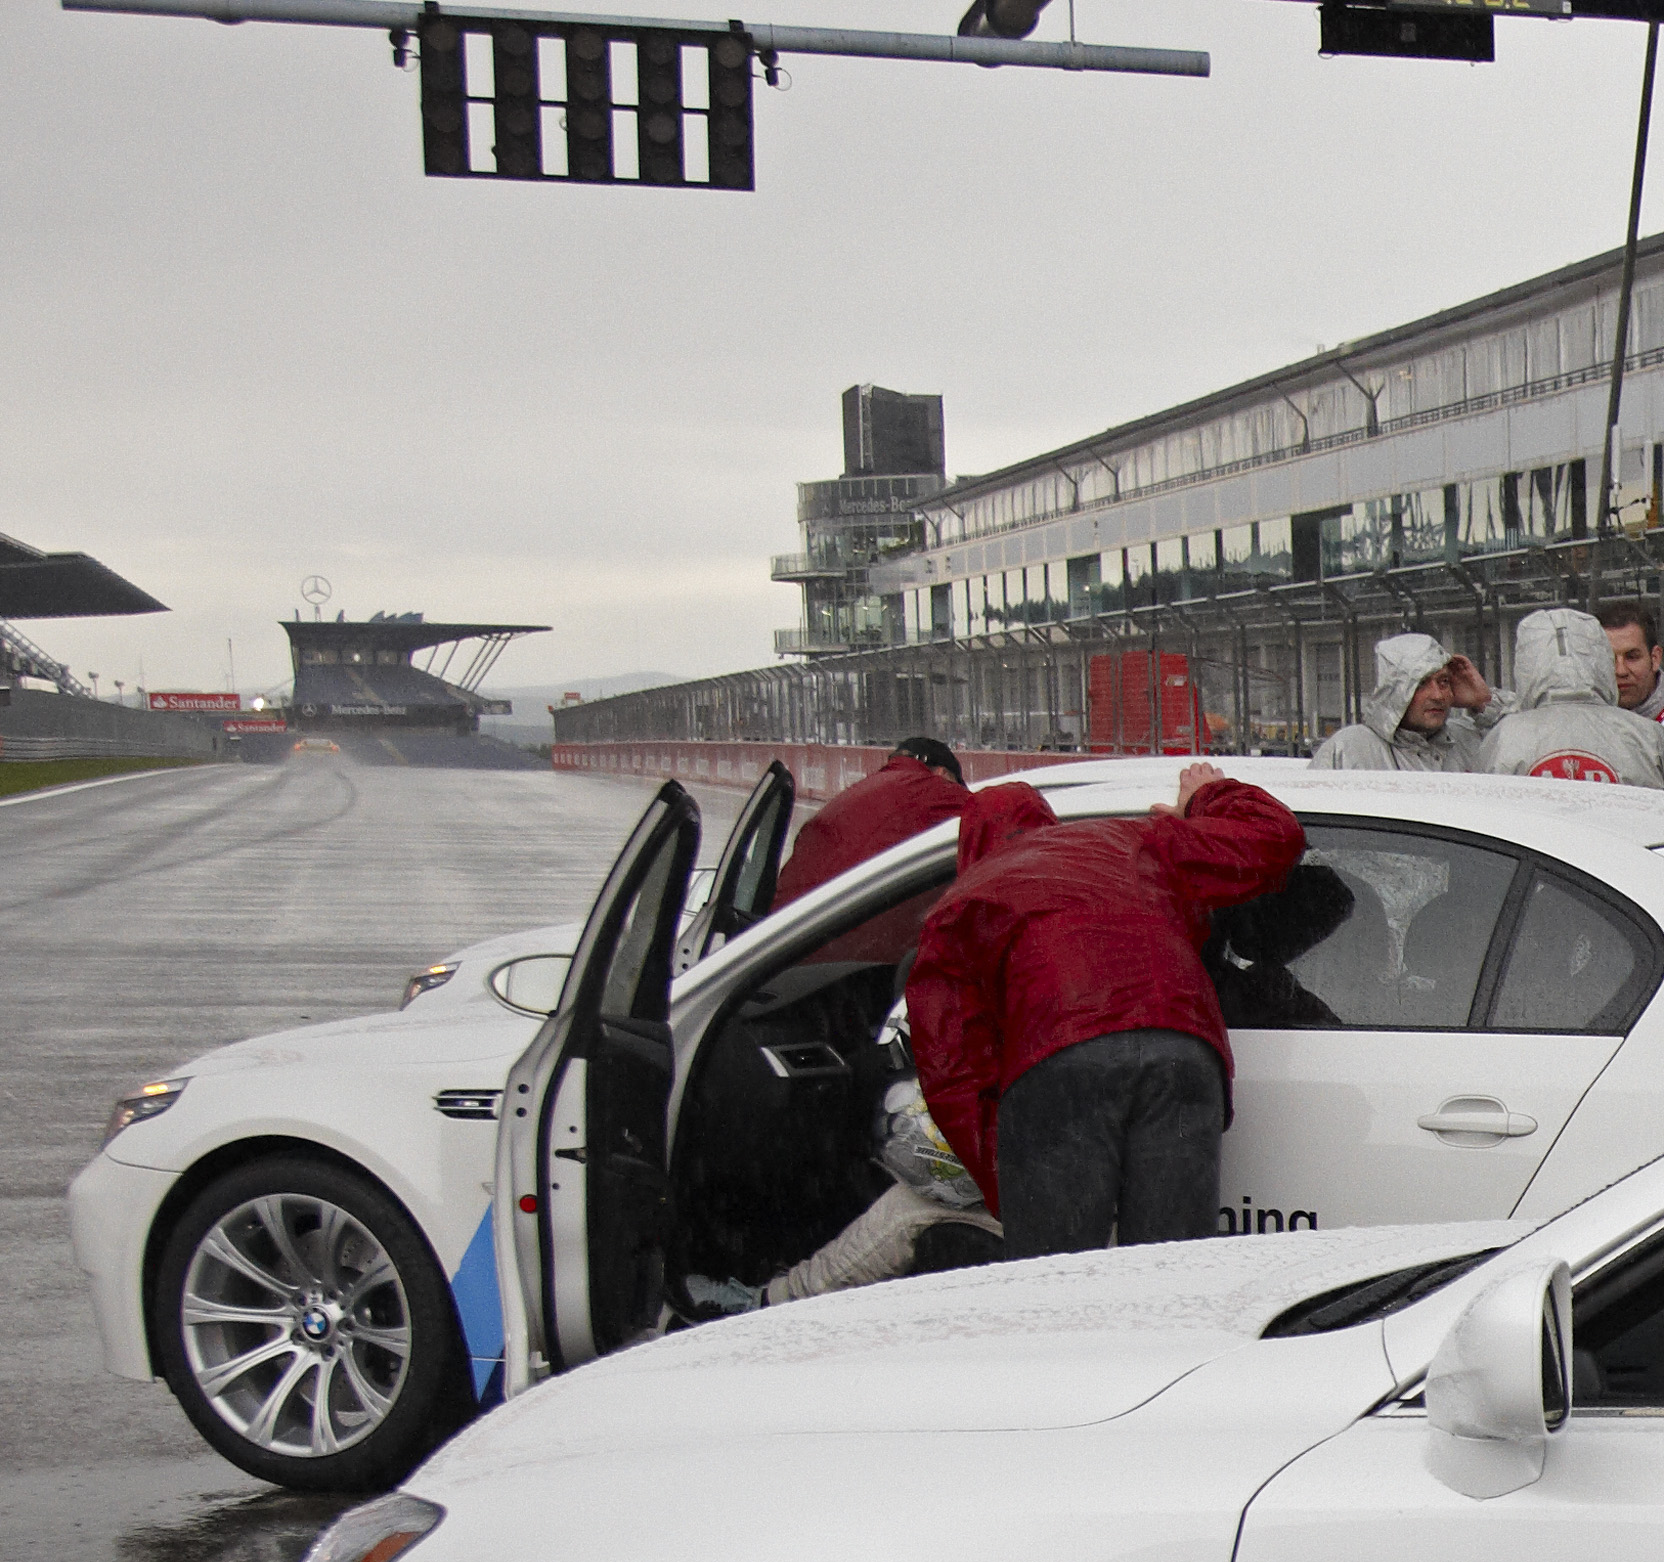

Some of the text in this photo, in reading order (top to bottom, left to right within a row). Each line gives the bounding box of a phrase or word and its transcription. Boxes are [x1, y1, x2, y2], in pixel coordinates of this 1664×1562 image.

[168, 695, 239, 711] Santander
[331, 703, 407, 717] Mercedes-Benz
[237, 721, 287, 733] Santander
